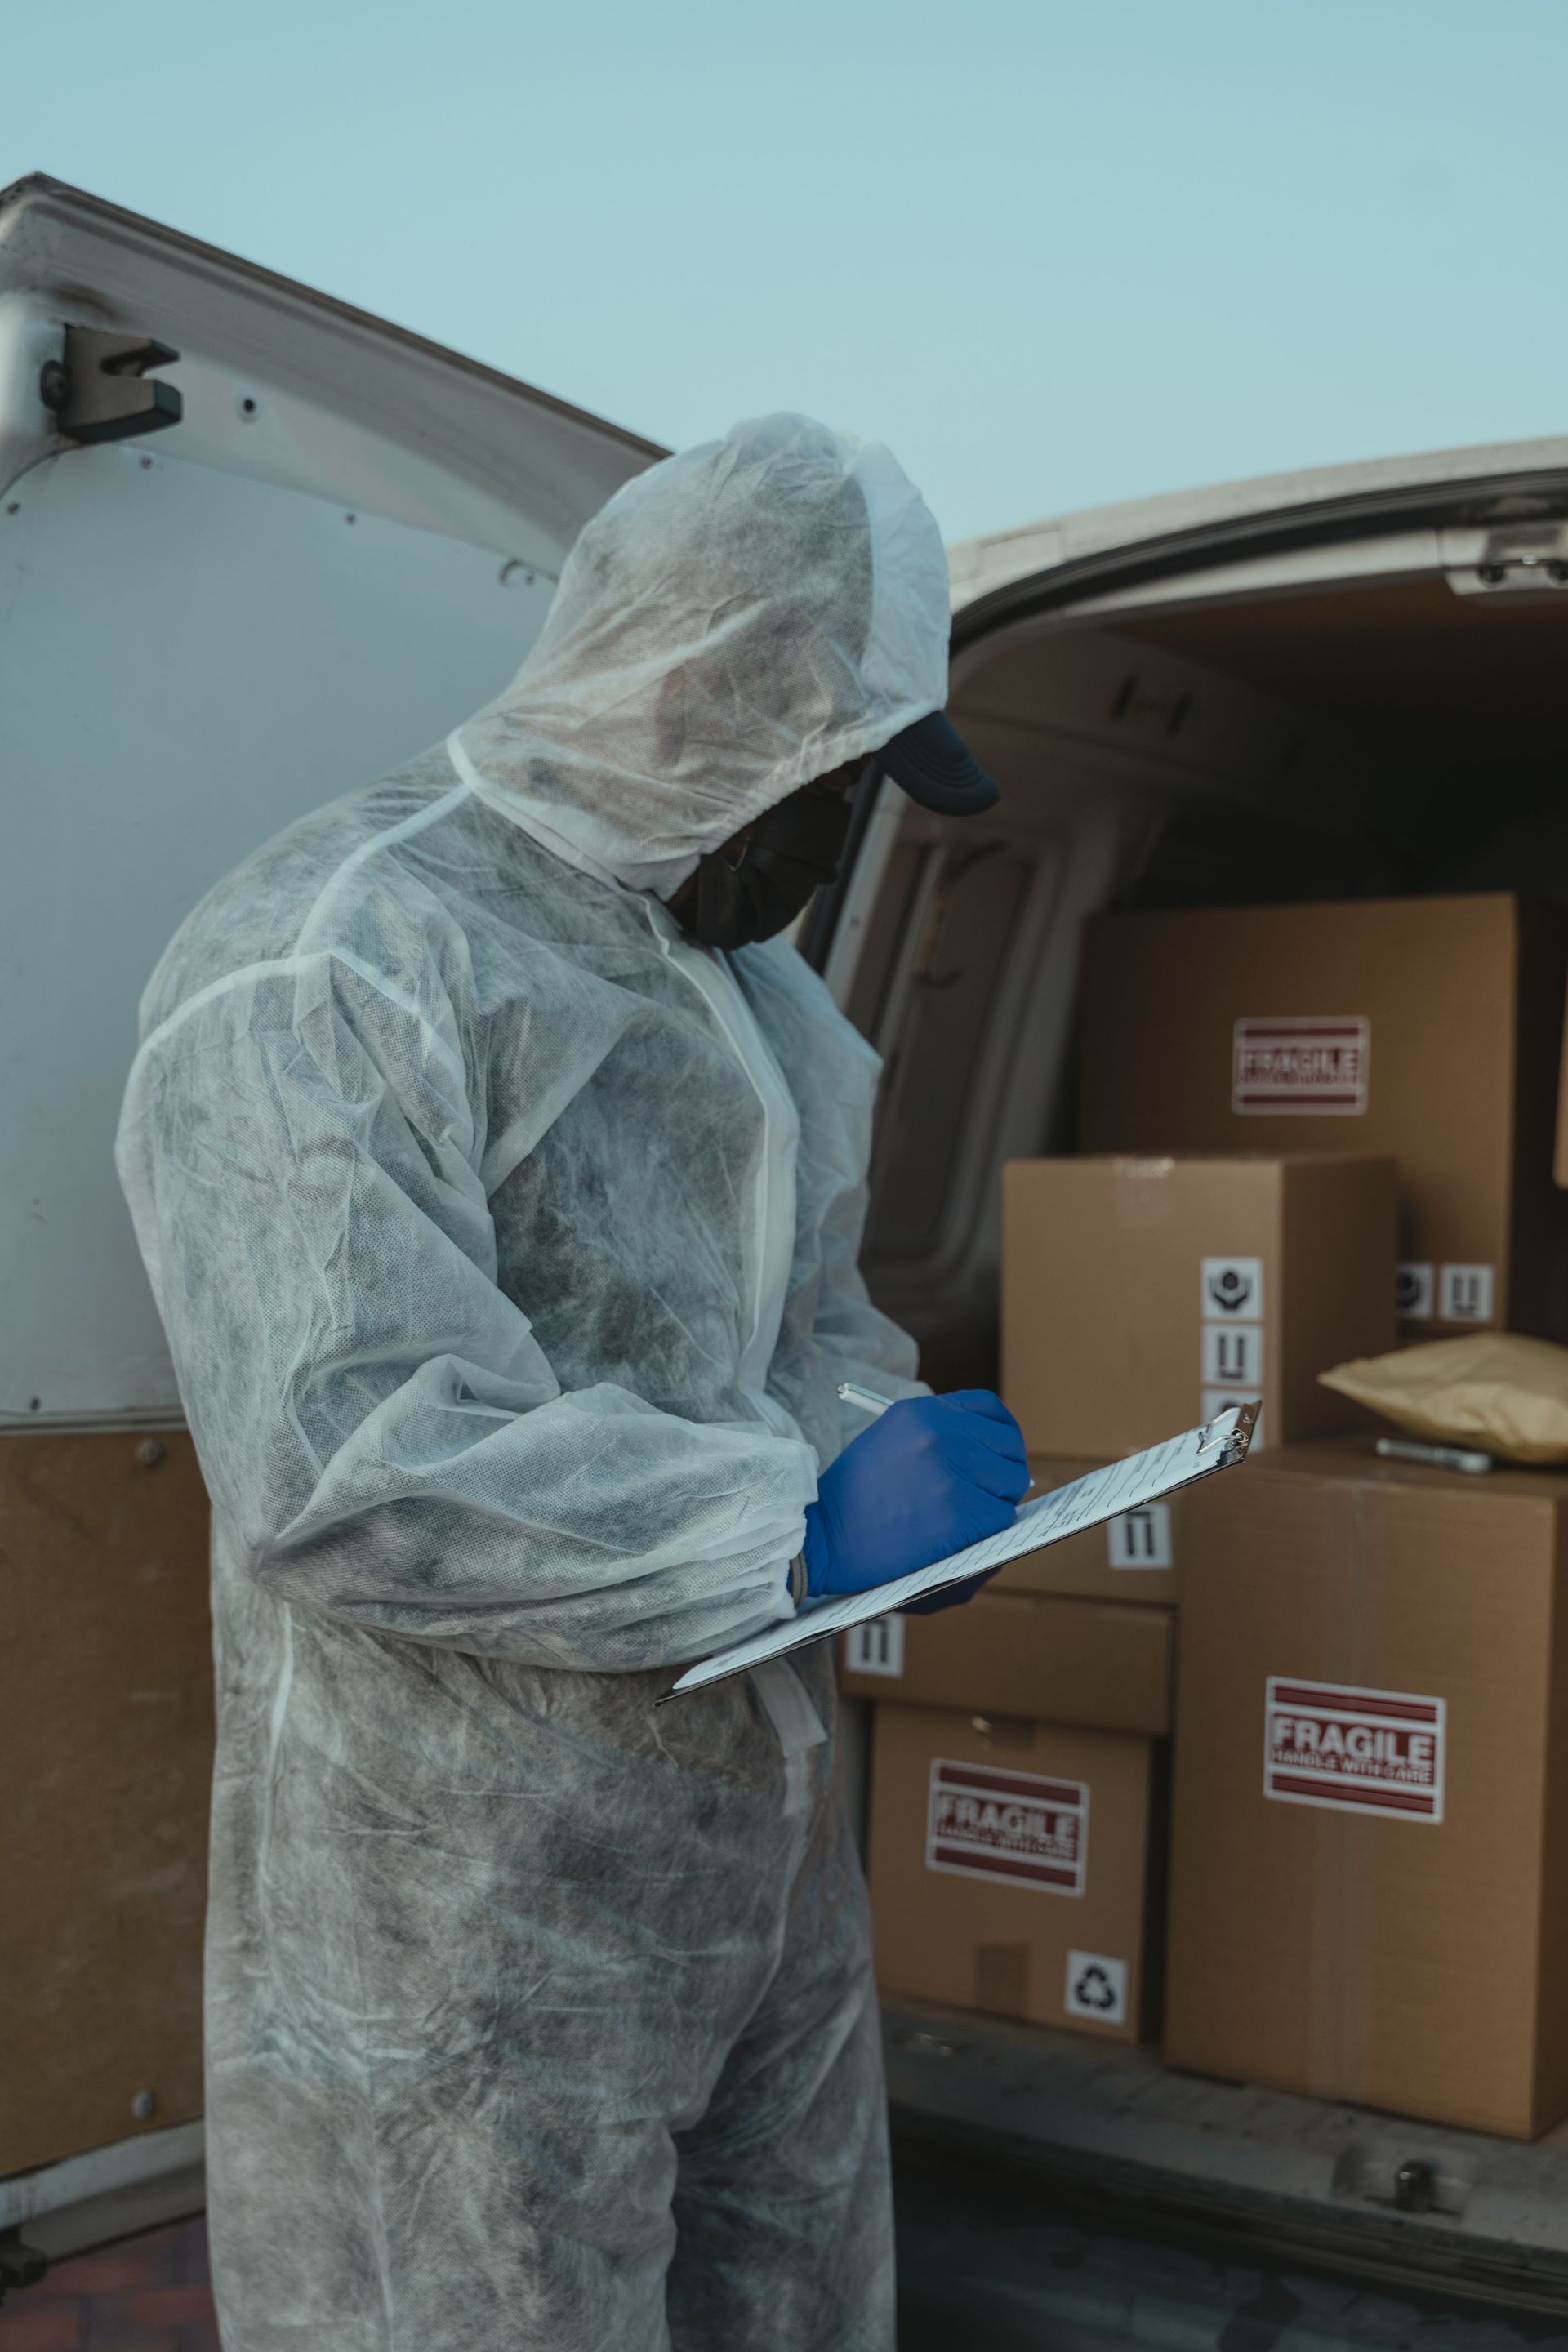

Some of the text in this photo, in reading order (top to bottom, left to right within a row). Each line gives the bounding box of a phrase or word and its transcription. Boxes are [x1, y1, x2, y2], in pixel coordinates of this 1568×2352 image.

[1273, 1748, 1339, 1770] HANDLE
[1341, 1756, 1380, 1777] WITH
[1274, 1716, 1432, 1766] FRAGILE
[938, 1795, 1076, 1843] FRAGILE
